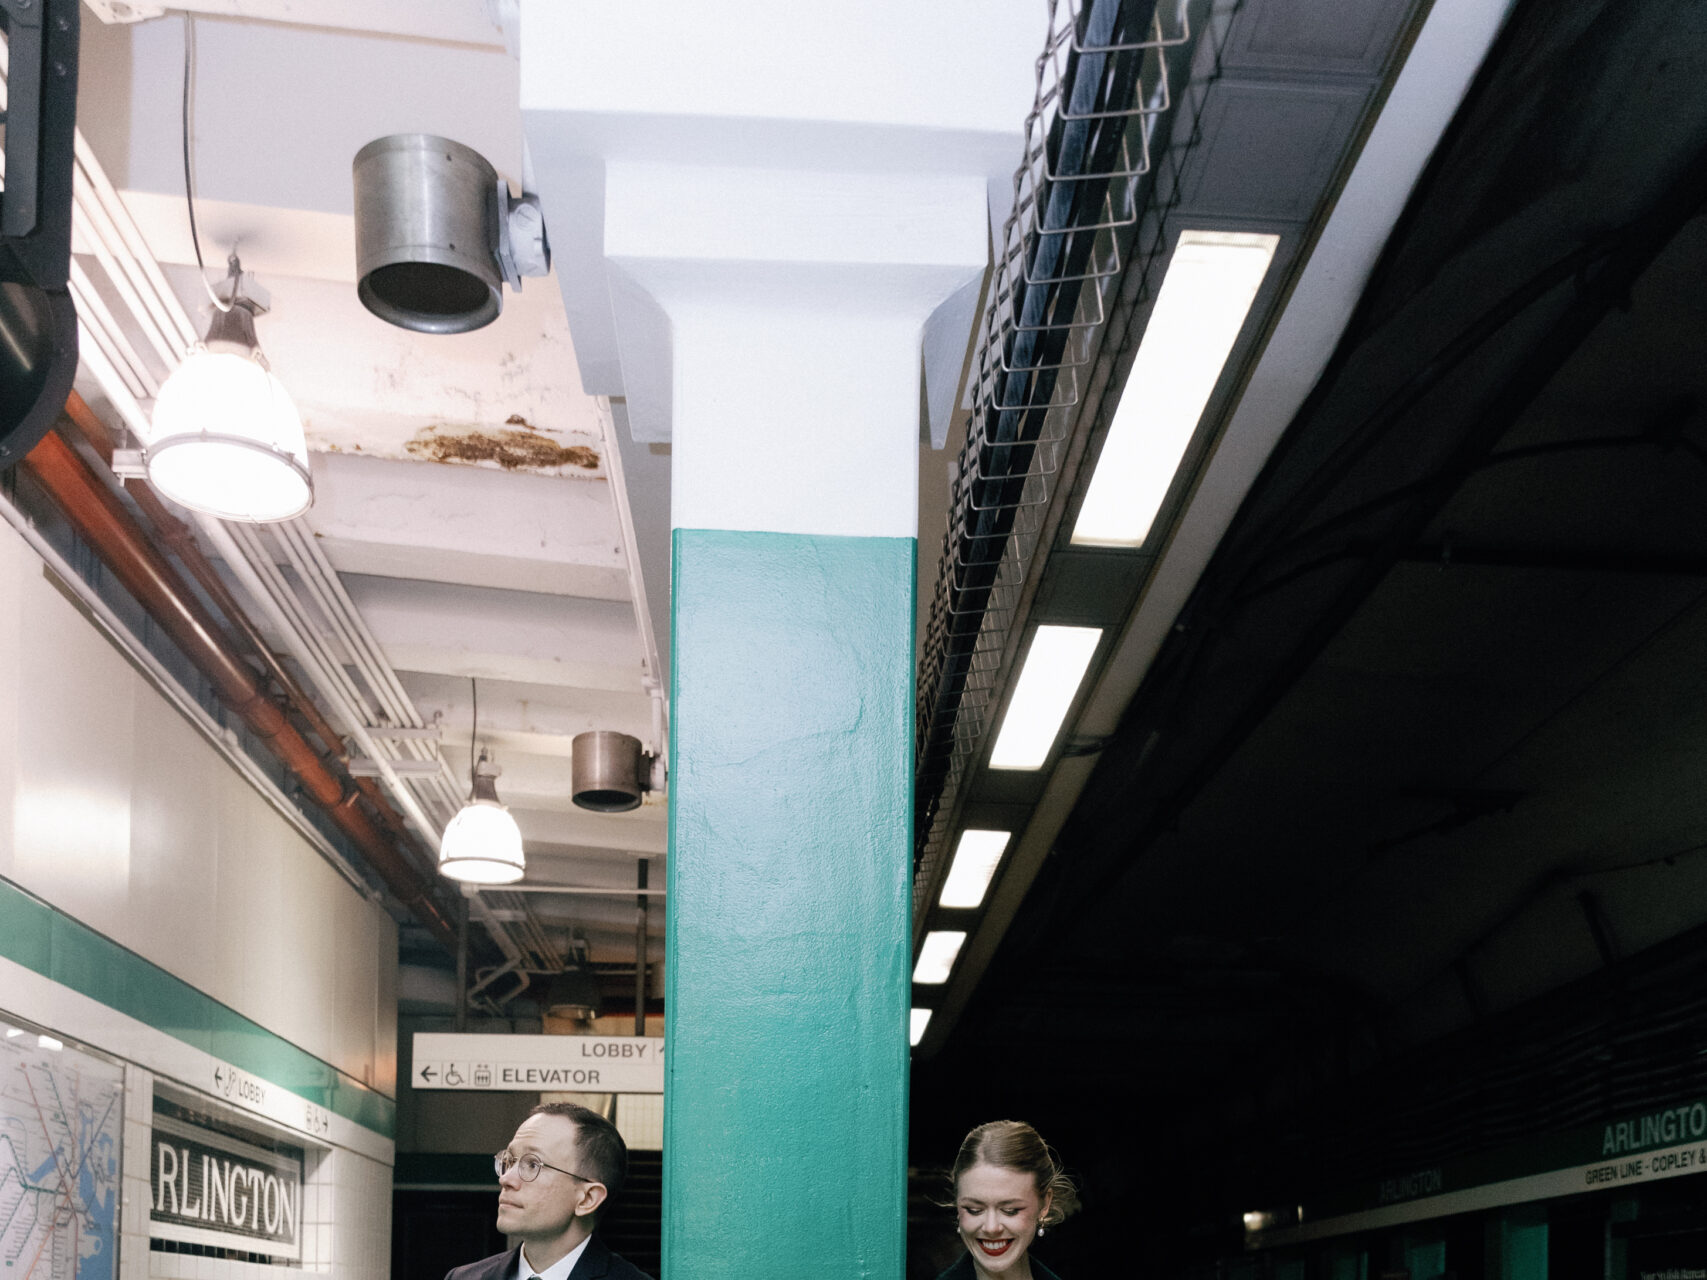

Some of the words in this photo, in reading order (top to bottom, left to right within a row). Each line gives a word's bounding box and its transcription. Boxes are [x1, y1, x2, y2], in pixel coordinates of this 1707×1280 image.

[582, 1043, 647, 1058] LOBBY
[502, 1068, 600, 1084] ELEVATOR
[238, 1078, 266, 1104] LOBBY
[1586, 1166, 1617, 1185] GREEN
[1620, 1160, 1642, 1178] LINE
[1652, 1151, 1695, 1173] COPLEY
[151, 1142, 295, 1237] RLINGTON
